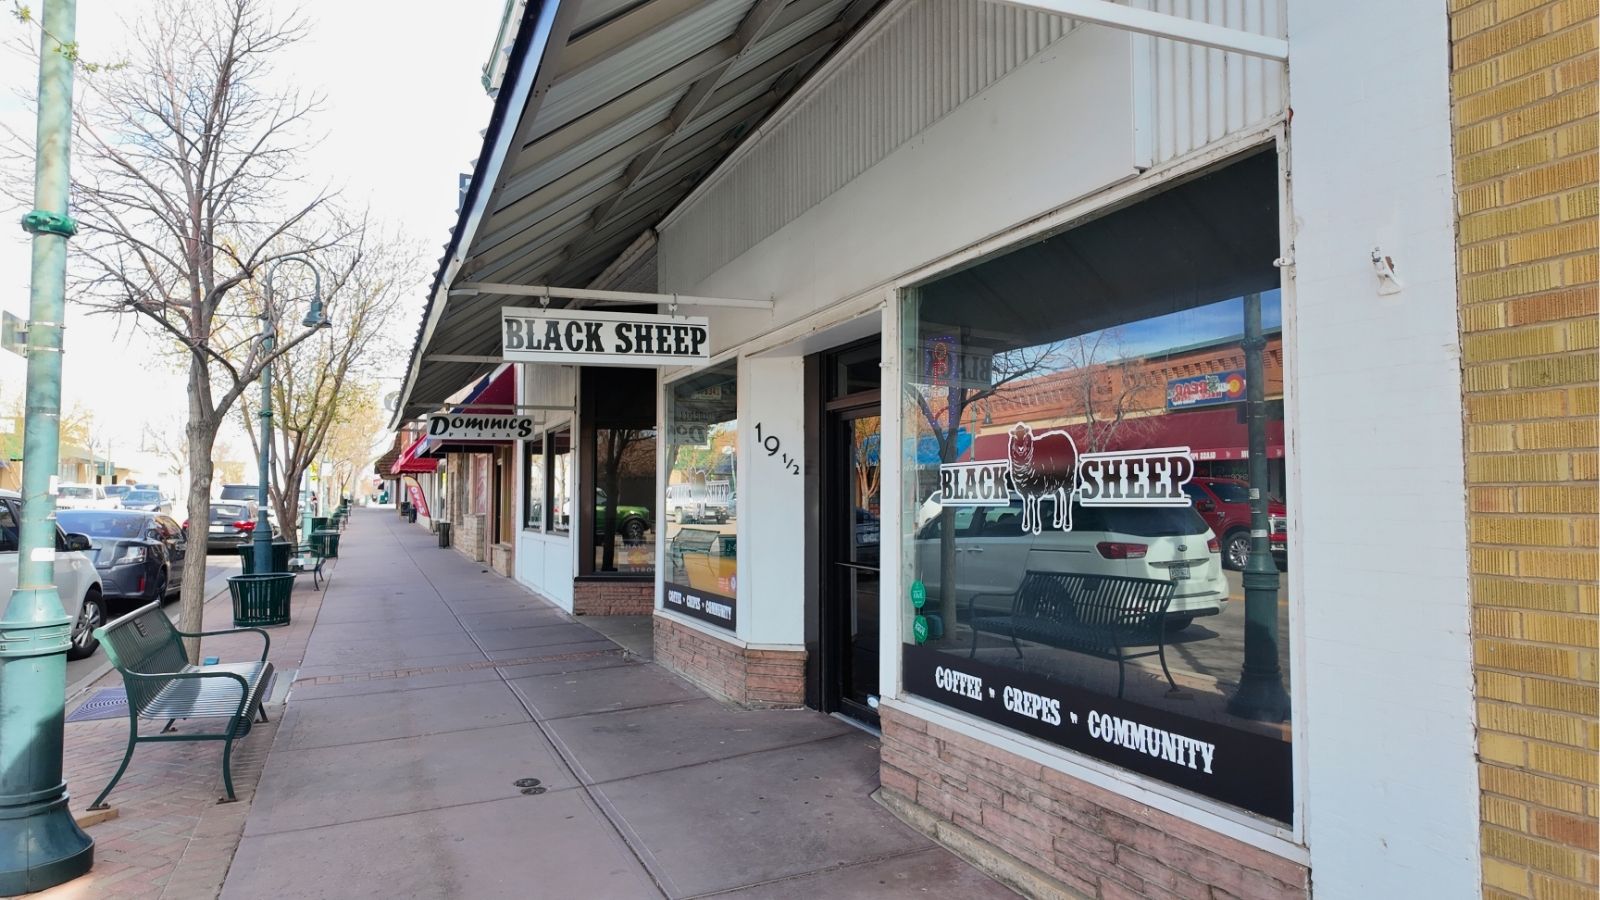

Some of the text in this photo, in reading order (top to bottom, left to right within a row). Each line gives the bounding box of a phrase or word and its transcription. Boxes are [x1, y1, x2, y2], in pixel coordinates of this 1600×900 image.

[504, 317, 708, 357] BLACK SHEEP
[755, 421, 780, 457] 19
[941, 456, 1193, 500] BLACK SHEEP
[935, 665, 1216, 775] COFFEE CREPES COMMUNITY
